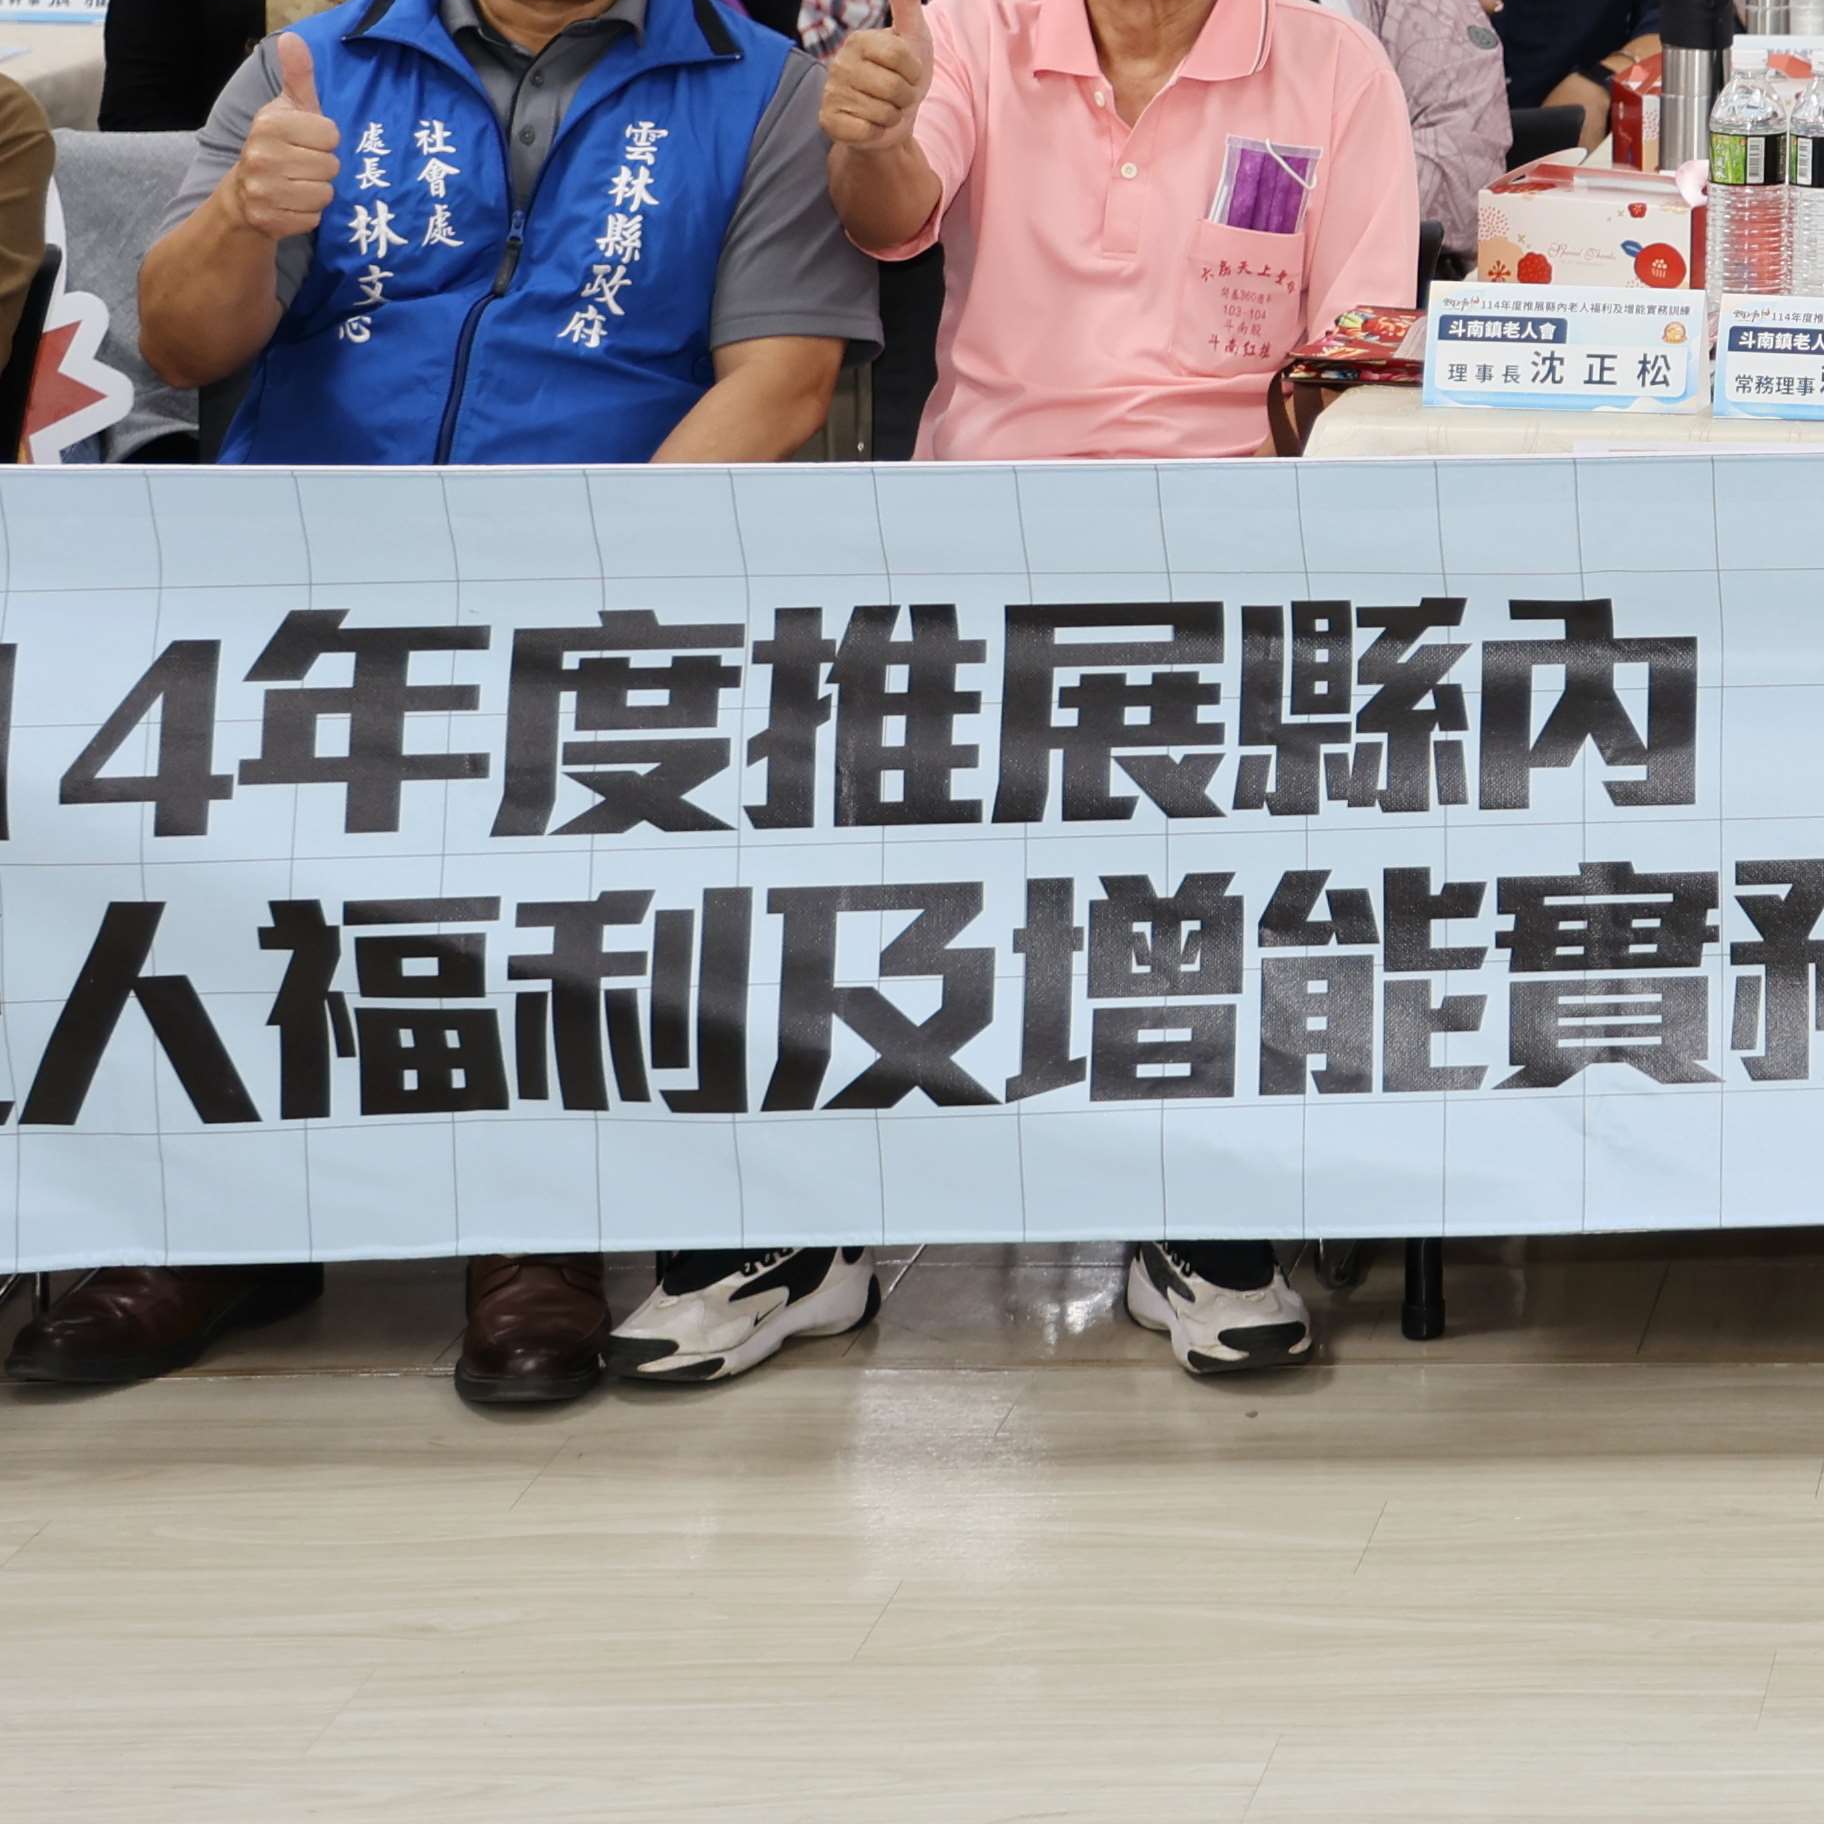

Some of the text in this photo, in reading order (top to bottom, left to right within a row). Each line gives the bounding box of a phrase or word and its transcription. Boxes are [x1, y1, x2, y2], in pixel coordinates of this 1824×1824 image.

[414, 120, 464, 248] 社會處
[558, 121, 668, 348] 雲林縣政府
[1448, 319, 1557, 340] 斗南鎮老人會
[1448, 350, 1671, 388] 理事長 沈正松
[1735, 375, 1815, 396] 常務理事
